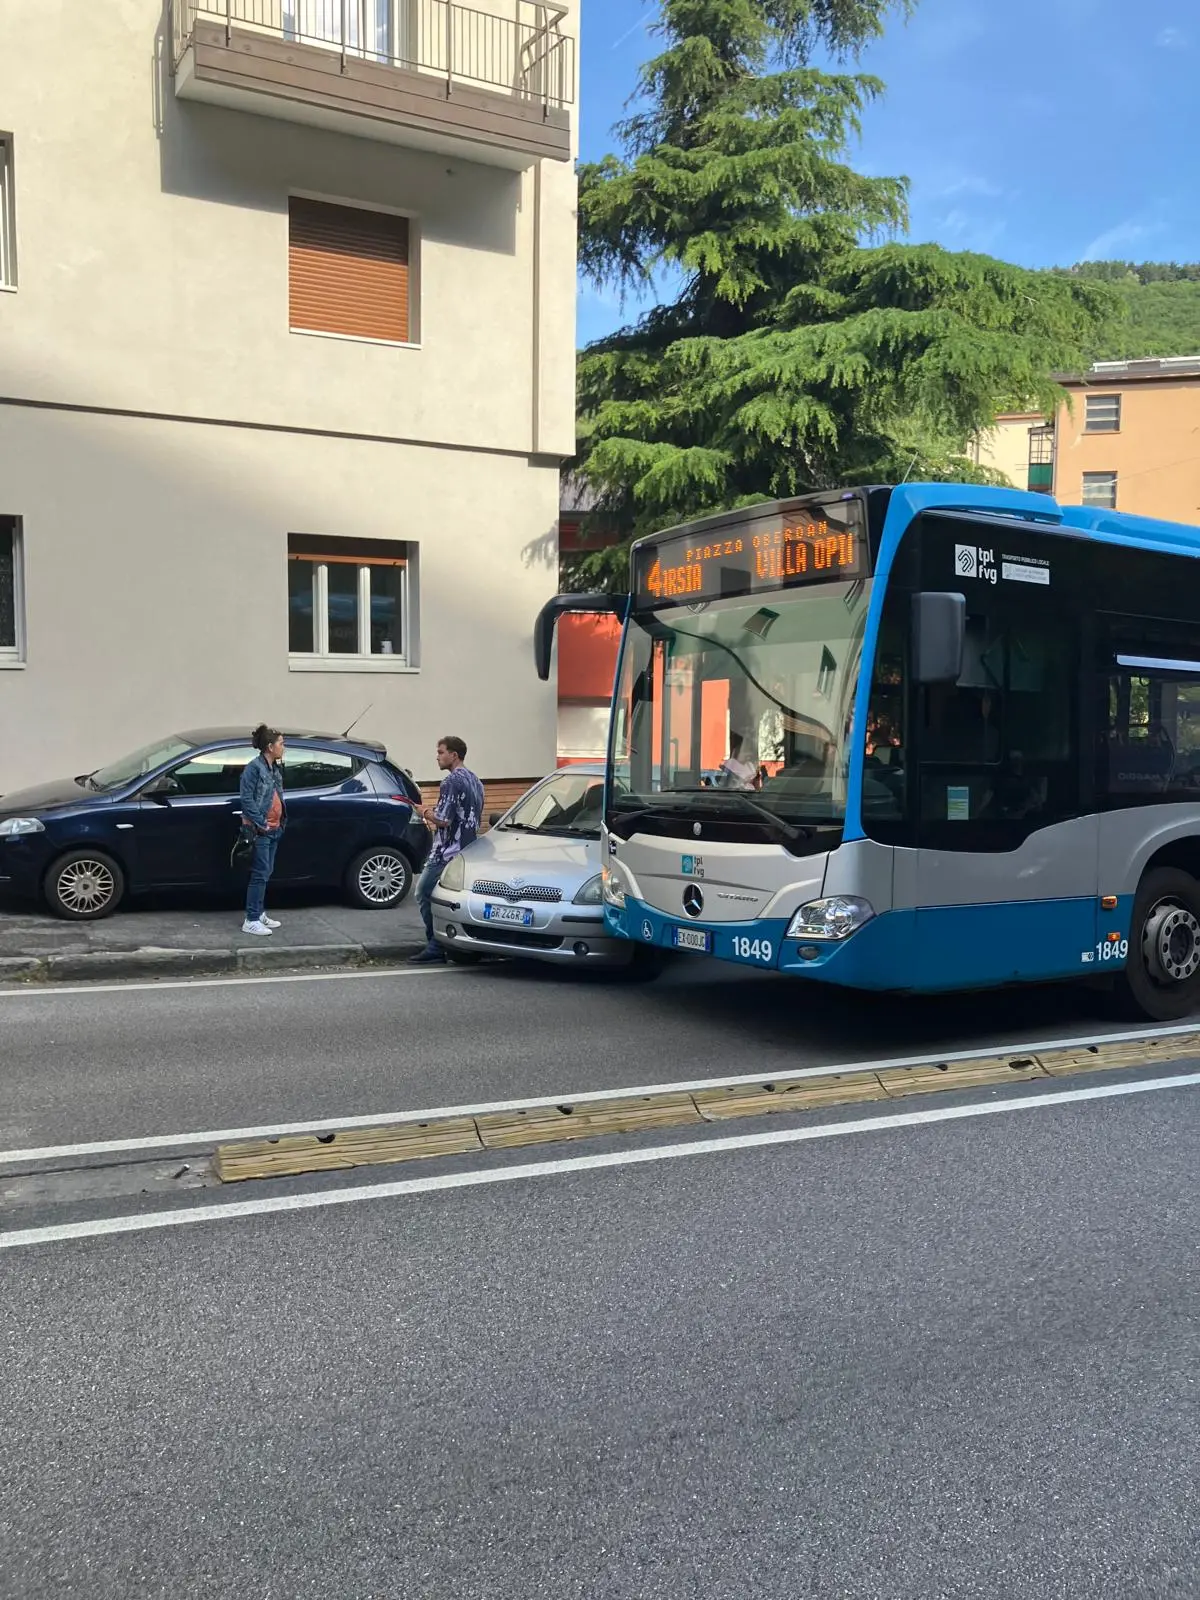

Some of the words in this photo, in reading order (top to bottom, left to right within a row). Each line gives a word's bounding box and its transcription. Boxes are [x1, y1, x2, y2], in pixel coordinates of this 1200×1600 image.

[686, 539, 743, 562] PIAZZA
[752, 521, 827, 548] OBERDAN
[978, 547, 995, 566] tpl
[647, 558, 661, 598] 4
[978, 564, 998, 585] fvg
[693, 866, 705, 878] fvg
[694, 856, 703, 867] tpl
[731, 936, 773, 962] 1849
[1095, 939, 1129, 961] 1849
